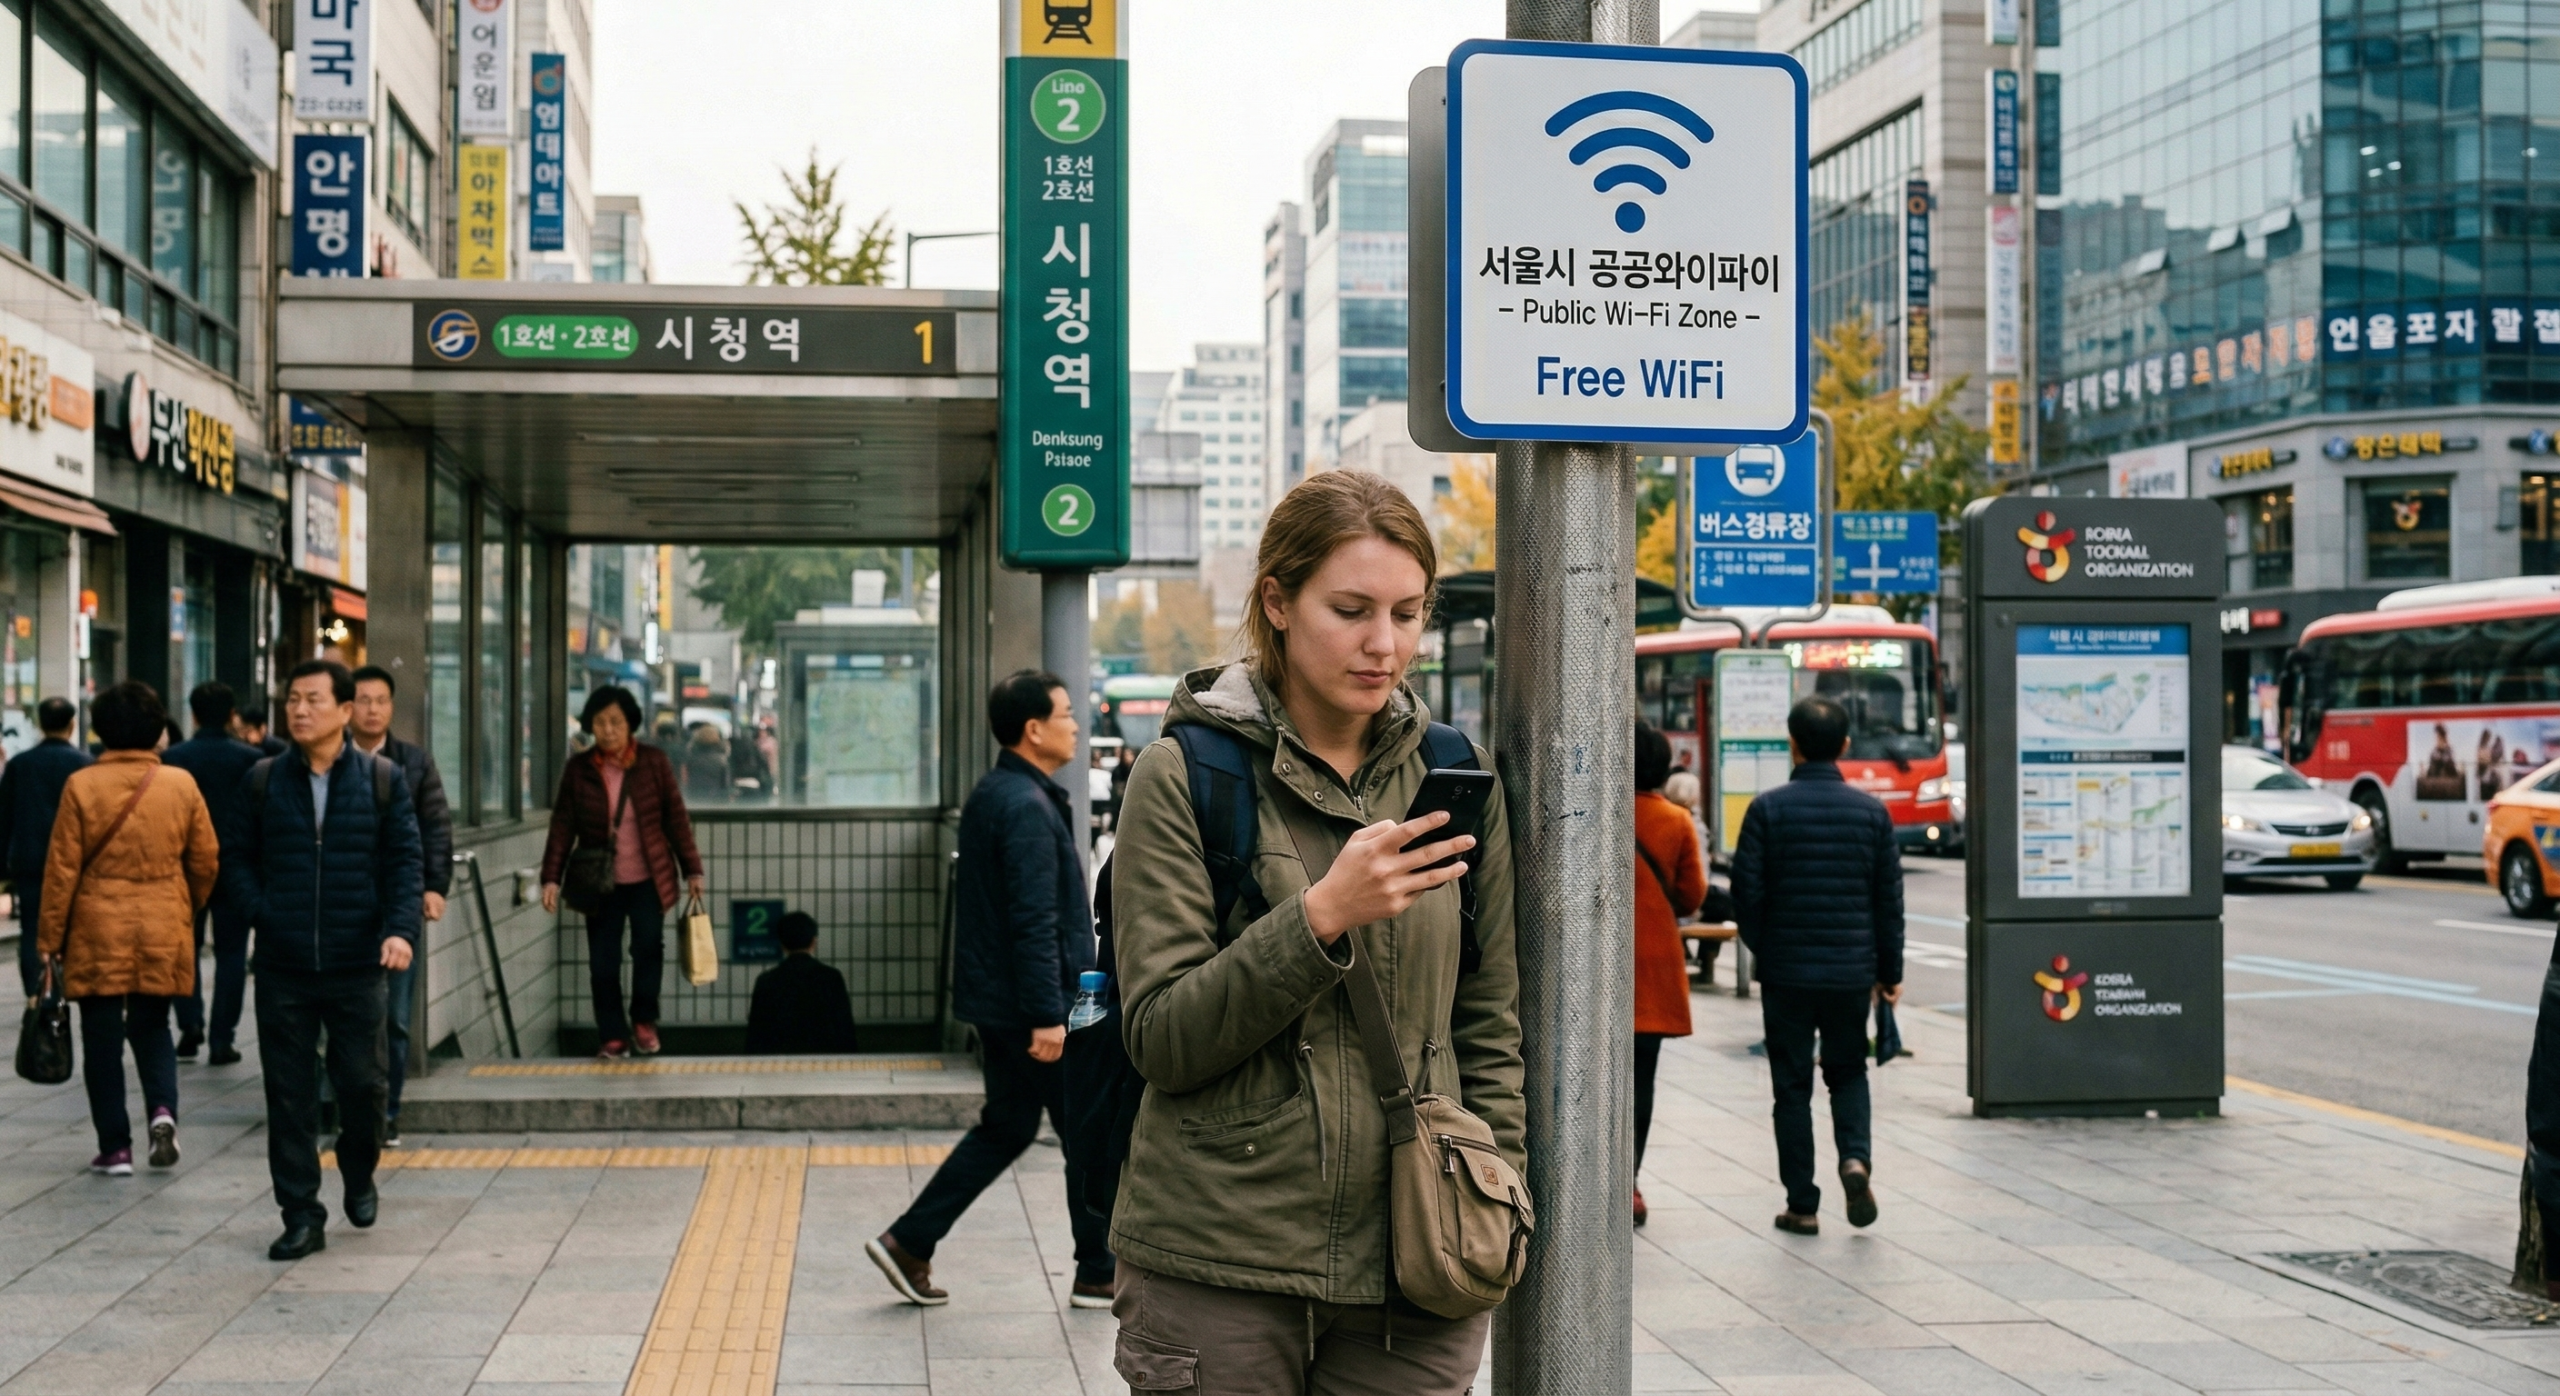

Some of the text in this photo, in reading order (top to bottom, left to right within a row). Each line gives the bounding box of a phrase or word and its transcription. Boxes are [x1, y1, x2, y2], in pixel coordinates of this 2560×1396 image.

[1057, 97, 1080, 132] 2
[1043, 155, 1095, 178] 1호선
[1042, 180, 1095, 203] 2호선
[1479, 245, 1779, 292] 서울시 공공와이파이
[1042, 223, 1091, 409] 시청역
[1523, 298, 1596, 326] Public
[1605, 300, 1670, 327] Wi-Fi
[1679, 303, 1737, 329] Zone
[914, 319, 933, 364] 1
[1537, 356, 1725, 399] Free WiFi
[1032, 430, 1103, 451] Denksung
[1058, 494, 1079, 526] 2
[747, 907, 769, 935] 2
